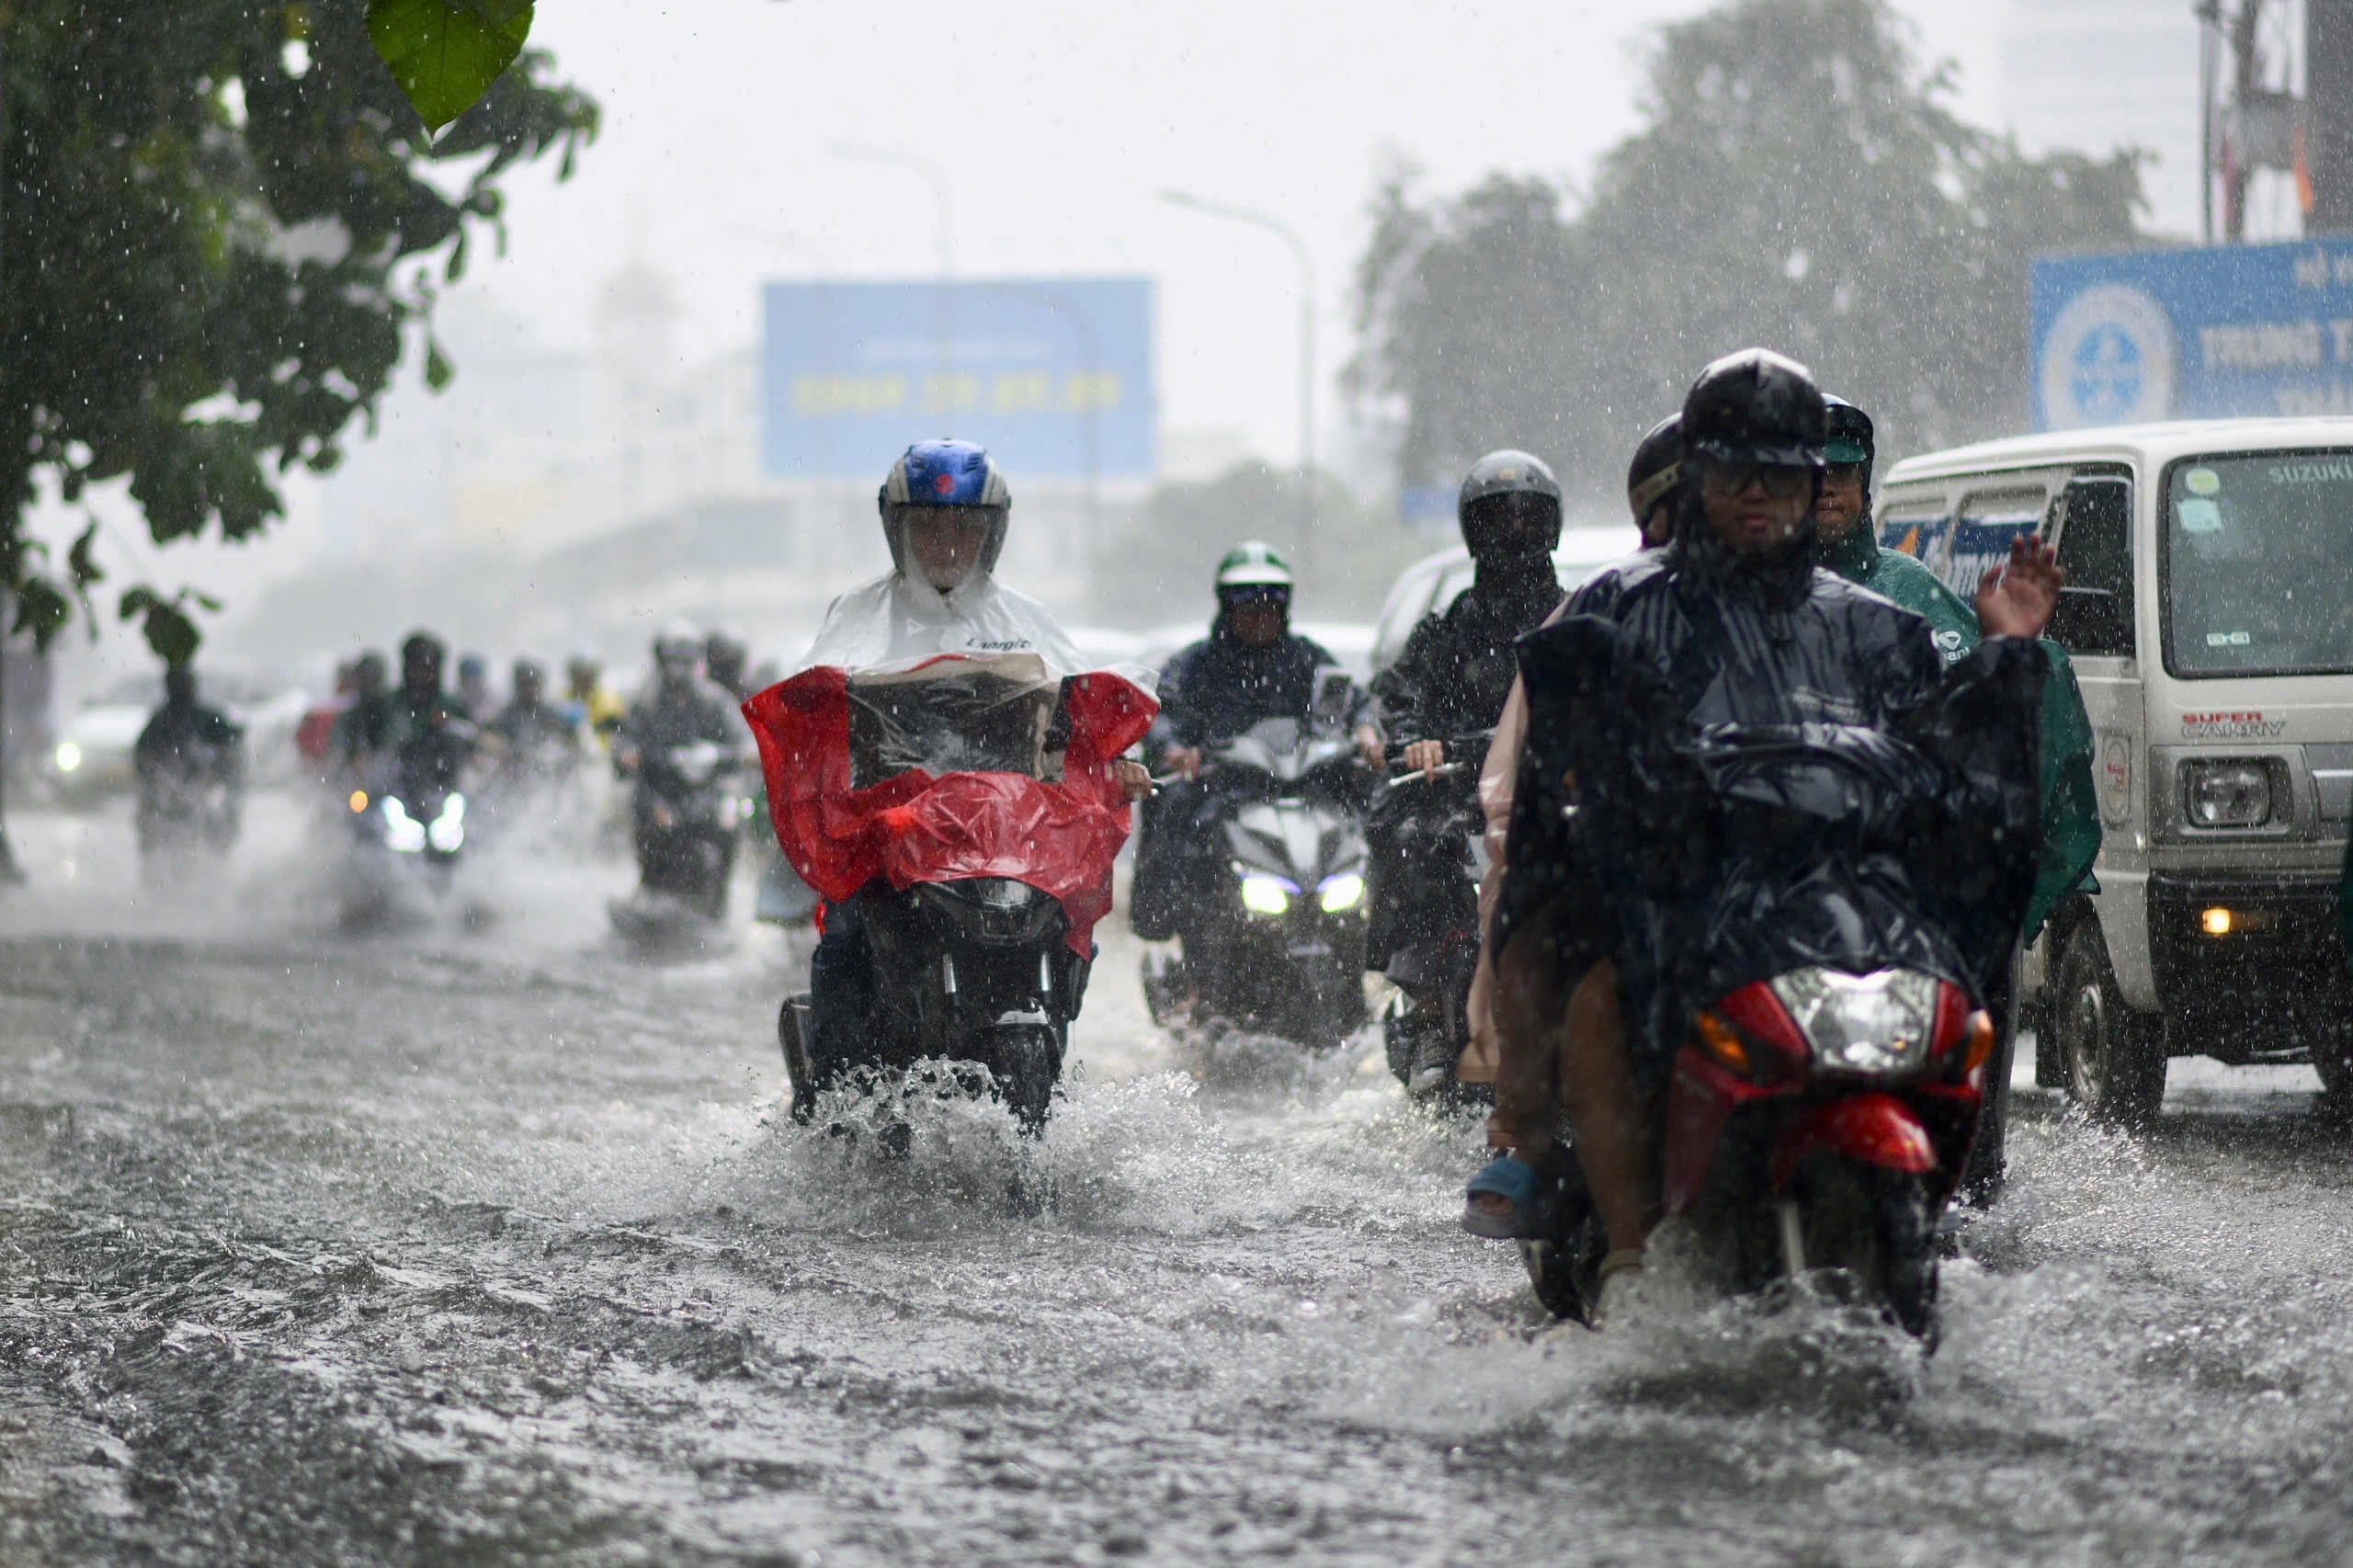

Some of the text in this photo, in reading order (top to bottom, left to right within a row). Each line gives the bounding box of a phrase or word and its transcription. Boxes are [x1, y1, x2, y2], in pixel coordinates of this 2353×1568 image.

[2268, 463, 2353, 483] SUZUKI
[2183, 712, 2263, 723] SUPER
[2181, 722, 2286, 737] CARRY
